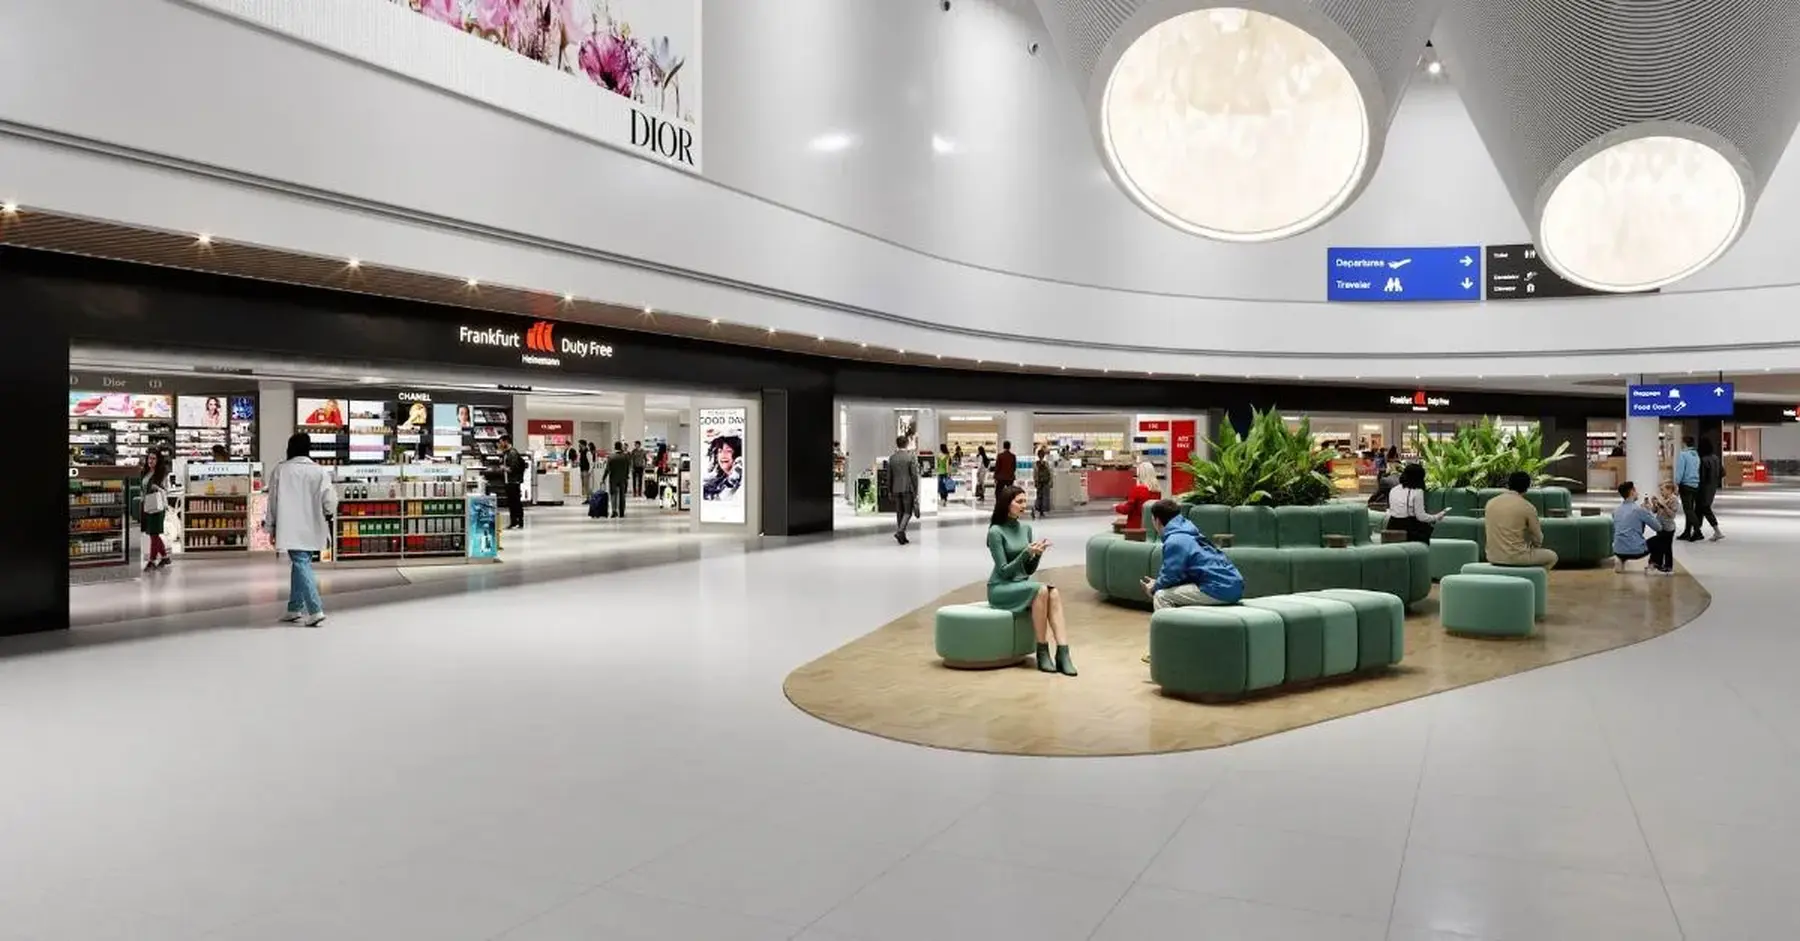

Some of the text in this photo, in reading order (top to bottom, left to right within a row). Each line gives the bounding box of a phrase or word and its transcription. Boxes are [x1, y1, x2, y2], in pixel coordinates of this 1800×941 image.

[629, 108, 694, 165] DIOR
[1335, 258, 1385, 268] Departures
[1336, 279, 1370, 289] Traveler
[459, 326, 613, 358] Frankfurt Duty Free
[522, 354, 560, 366] Heinemann
[102, 376, 127, 387] Dior
[398, 391, 432, 402] CHANEL
[1633, 403, 1651, 411] Food
